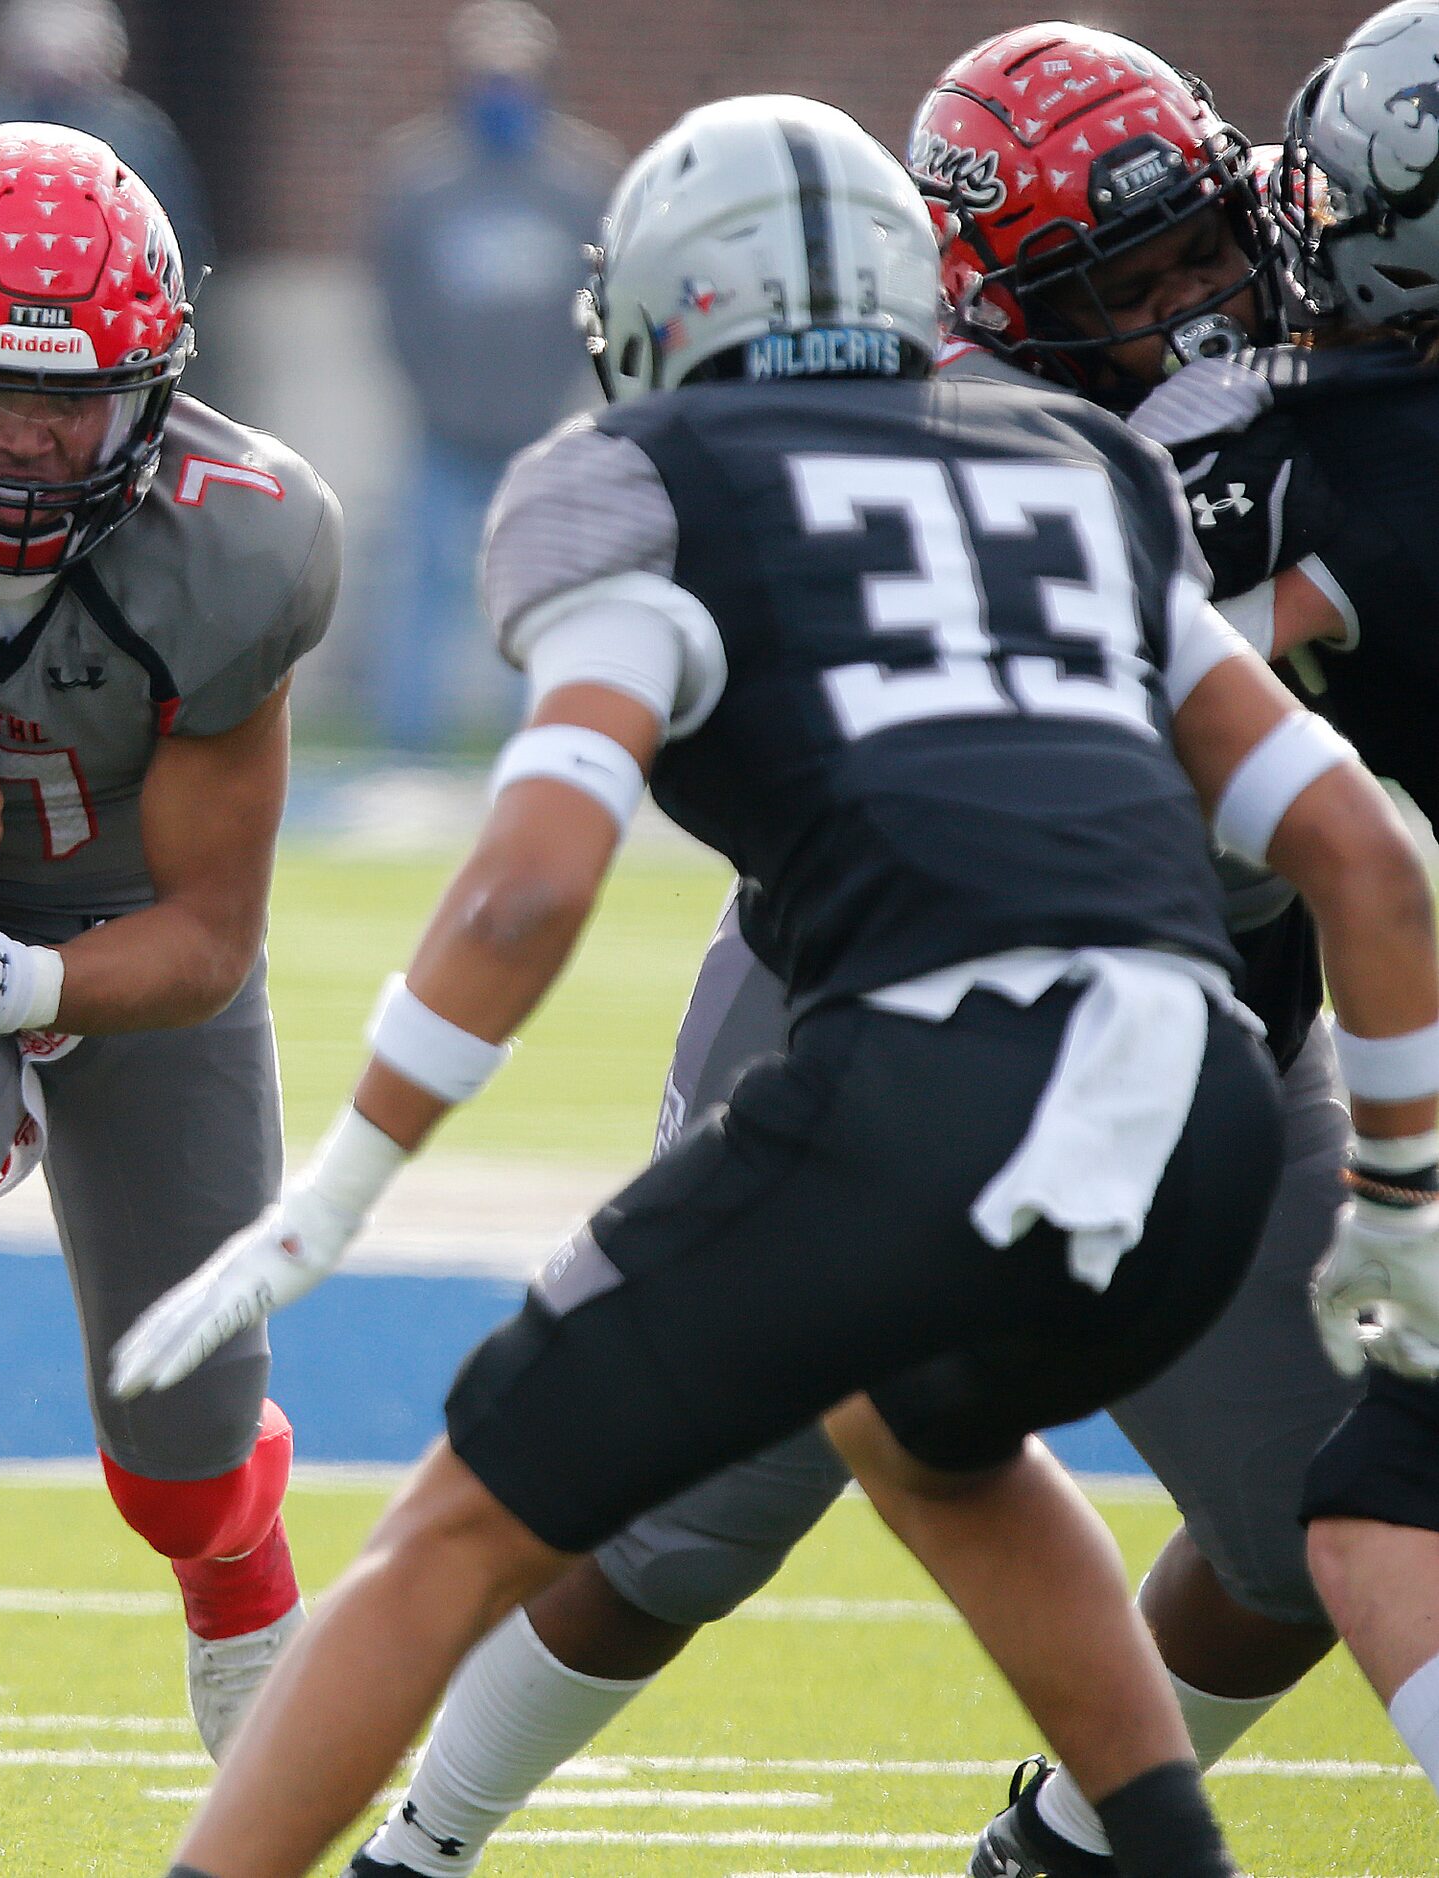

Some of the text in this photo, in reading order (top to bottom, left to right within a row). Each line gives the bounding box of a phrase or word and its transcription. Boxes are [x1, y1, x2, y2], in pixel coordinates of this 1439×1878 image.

[1114, 157, 1169, 193] TTHL
[14, 305, 71, 326] TTHL
[0, 331, 84, 355] Riddell
[747, 329, 901, 382] WILDCATS
[175, 453, 287, 507] 7
[785, 452, 1160, 742] 33
